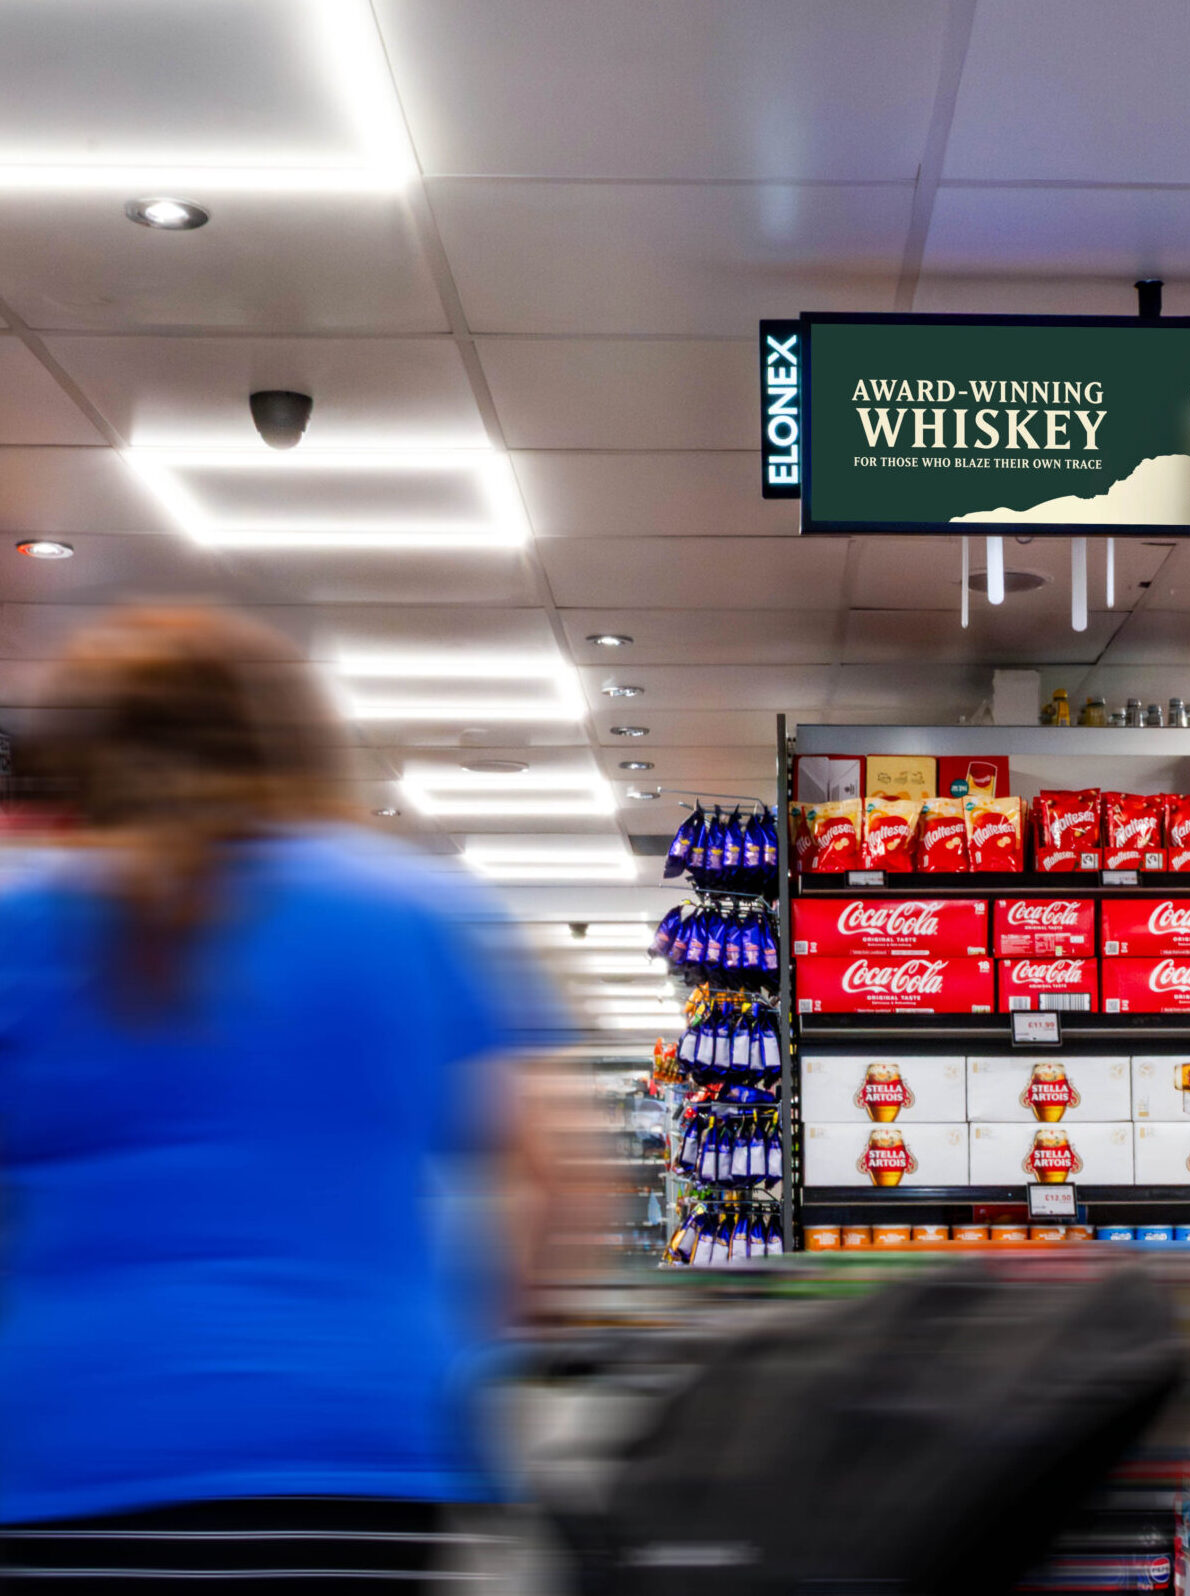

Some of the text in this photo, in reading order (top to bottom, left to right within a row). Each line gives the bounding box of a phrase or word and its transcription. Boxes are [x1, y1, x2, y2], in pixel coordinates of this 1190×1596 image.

[852, 379, 1104, 404] AWARD-WINNING
[767, 335, 798, 484] ELONEX
[856, 407, 1107, 450] WHISKEY
[854, 456, 1102, 470] FOR THOSE WHO BLAZE THEIR OWN TRACE
[838, 901, 945, 935] Coca-Cola
[1008, 901, 1081, 925] Coca-Cola
[842, 959, 949, 993] Coca-Cola
[1012, 959, 1085, 983] Coca-Cola
[865, 1084, 902, 1093] STELLA
[1031, 1084, 1068, 1092] STELLA
[865, 1093, 903, 1101] ARTOIS
[1031, 1093, 1069, 1101] ARTOIS
[868, 1150, 905, 1158] STELLA
[1034, 1150, 1070, 1158] STELLA
[868, 1159, 906, 1167] ARTOIS
[1034, 1159, 1071, 1167] ARTOIS
